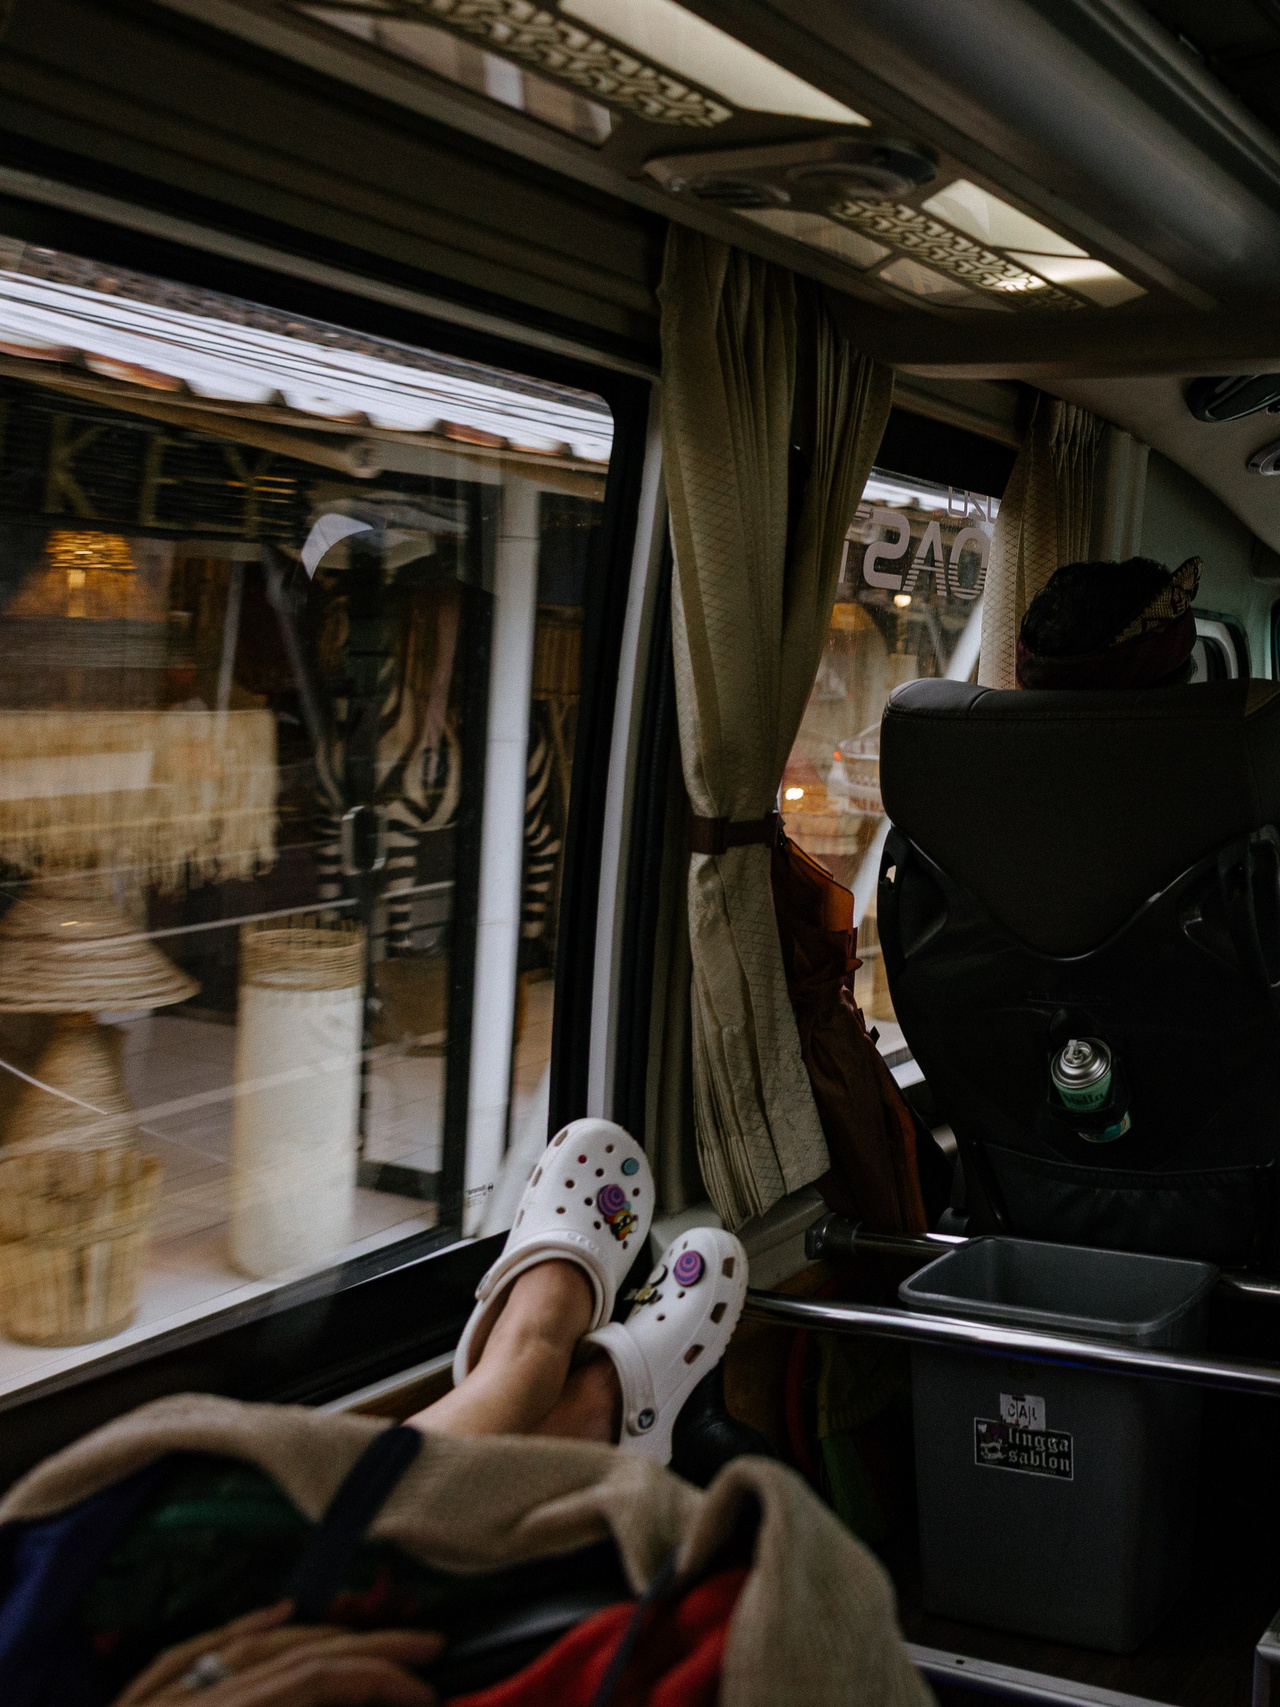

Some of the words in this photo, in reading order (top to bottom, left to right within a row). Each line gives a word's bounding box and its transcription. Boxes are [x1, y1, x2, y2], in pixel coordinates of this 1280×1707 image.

[0, 399, 275, 539] KEY
[1008, 1427, 1069, 1453] lingga
[1008, 1448, 1071, 1472] sablon
